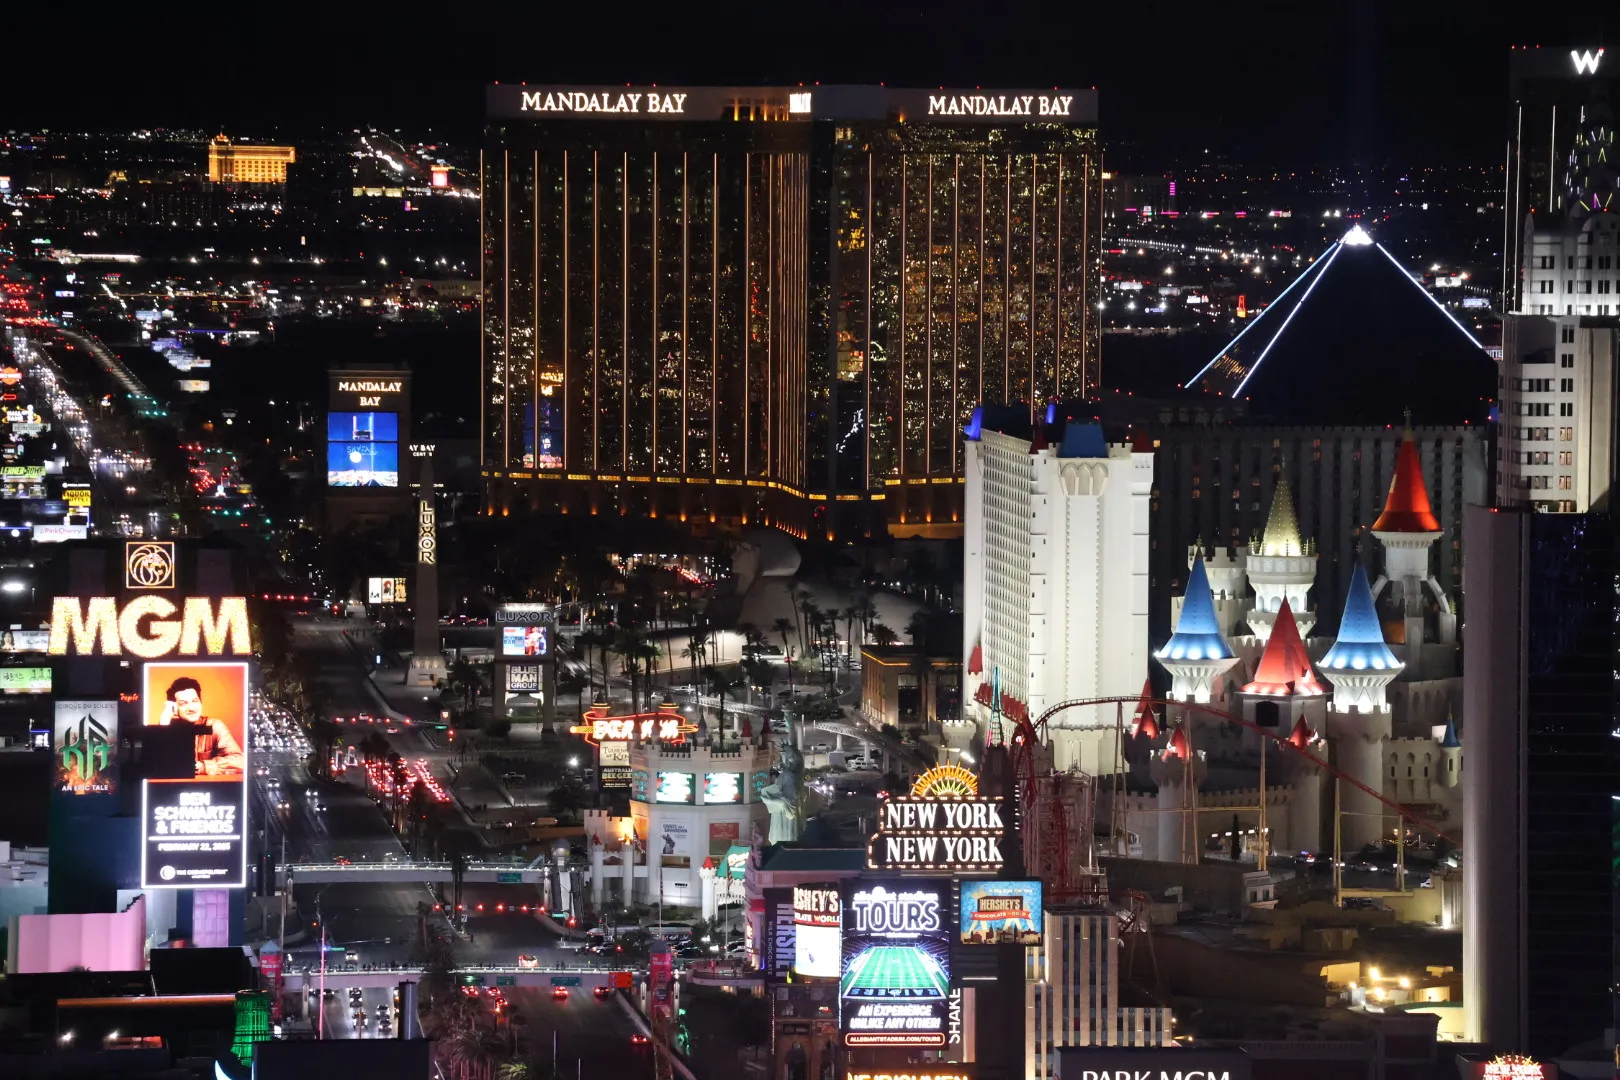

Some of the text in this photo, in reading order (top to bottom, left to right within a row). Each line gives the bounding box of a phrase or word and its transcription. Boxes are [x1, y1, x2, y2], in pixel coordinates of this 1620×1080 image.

[1571, 49, 1602, 75] W
[521, 91, 687, 113] MANDALAY BAY
[928, 95, 1073, 115] MANDALAY BAY
[339, 382, 402, 392] MANDALAY
[360, 396, 381, 406] BAY
[420, 444, 436, 452] BAY
[420, 501, 436, 564] LUXOR
[496, 611, 554, 623] LUXOR
[47, 595, 251, 656] MGM
[511, 666, 537, 674] BLUE
[511, 674, 537, 682] MAN
[180, 792, 210, 806] BEN
[154, 806, 235, 820] SCHWARTZ
[886, 803, 1004, 828] NEW YORK
[156, 820, 233, 834] & FRIENDS
[886, 837, 1004, 862] NEW YORK
[980, 898, 1020, 911] HERSHEY'S
[852, 900, 940, 931] TOURS
[974, 911, 1007, 919] CHOCOLATE
[858, 1004, 932, 1017] AN EXPERIENCE
[949, 987, 961, 1044] SHAKE
[849, 1017, 884, 1029] UNLIKE
[884, 1017, 905, 1029] ANY
